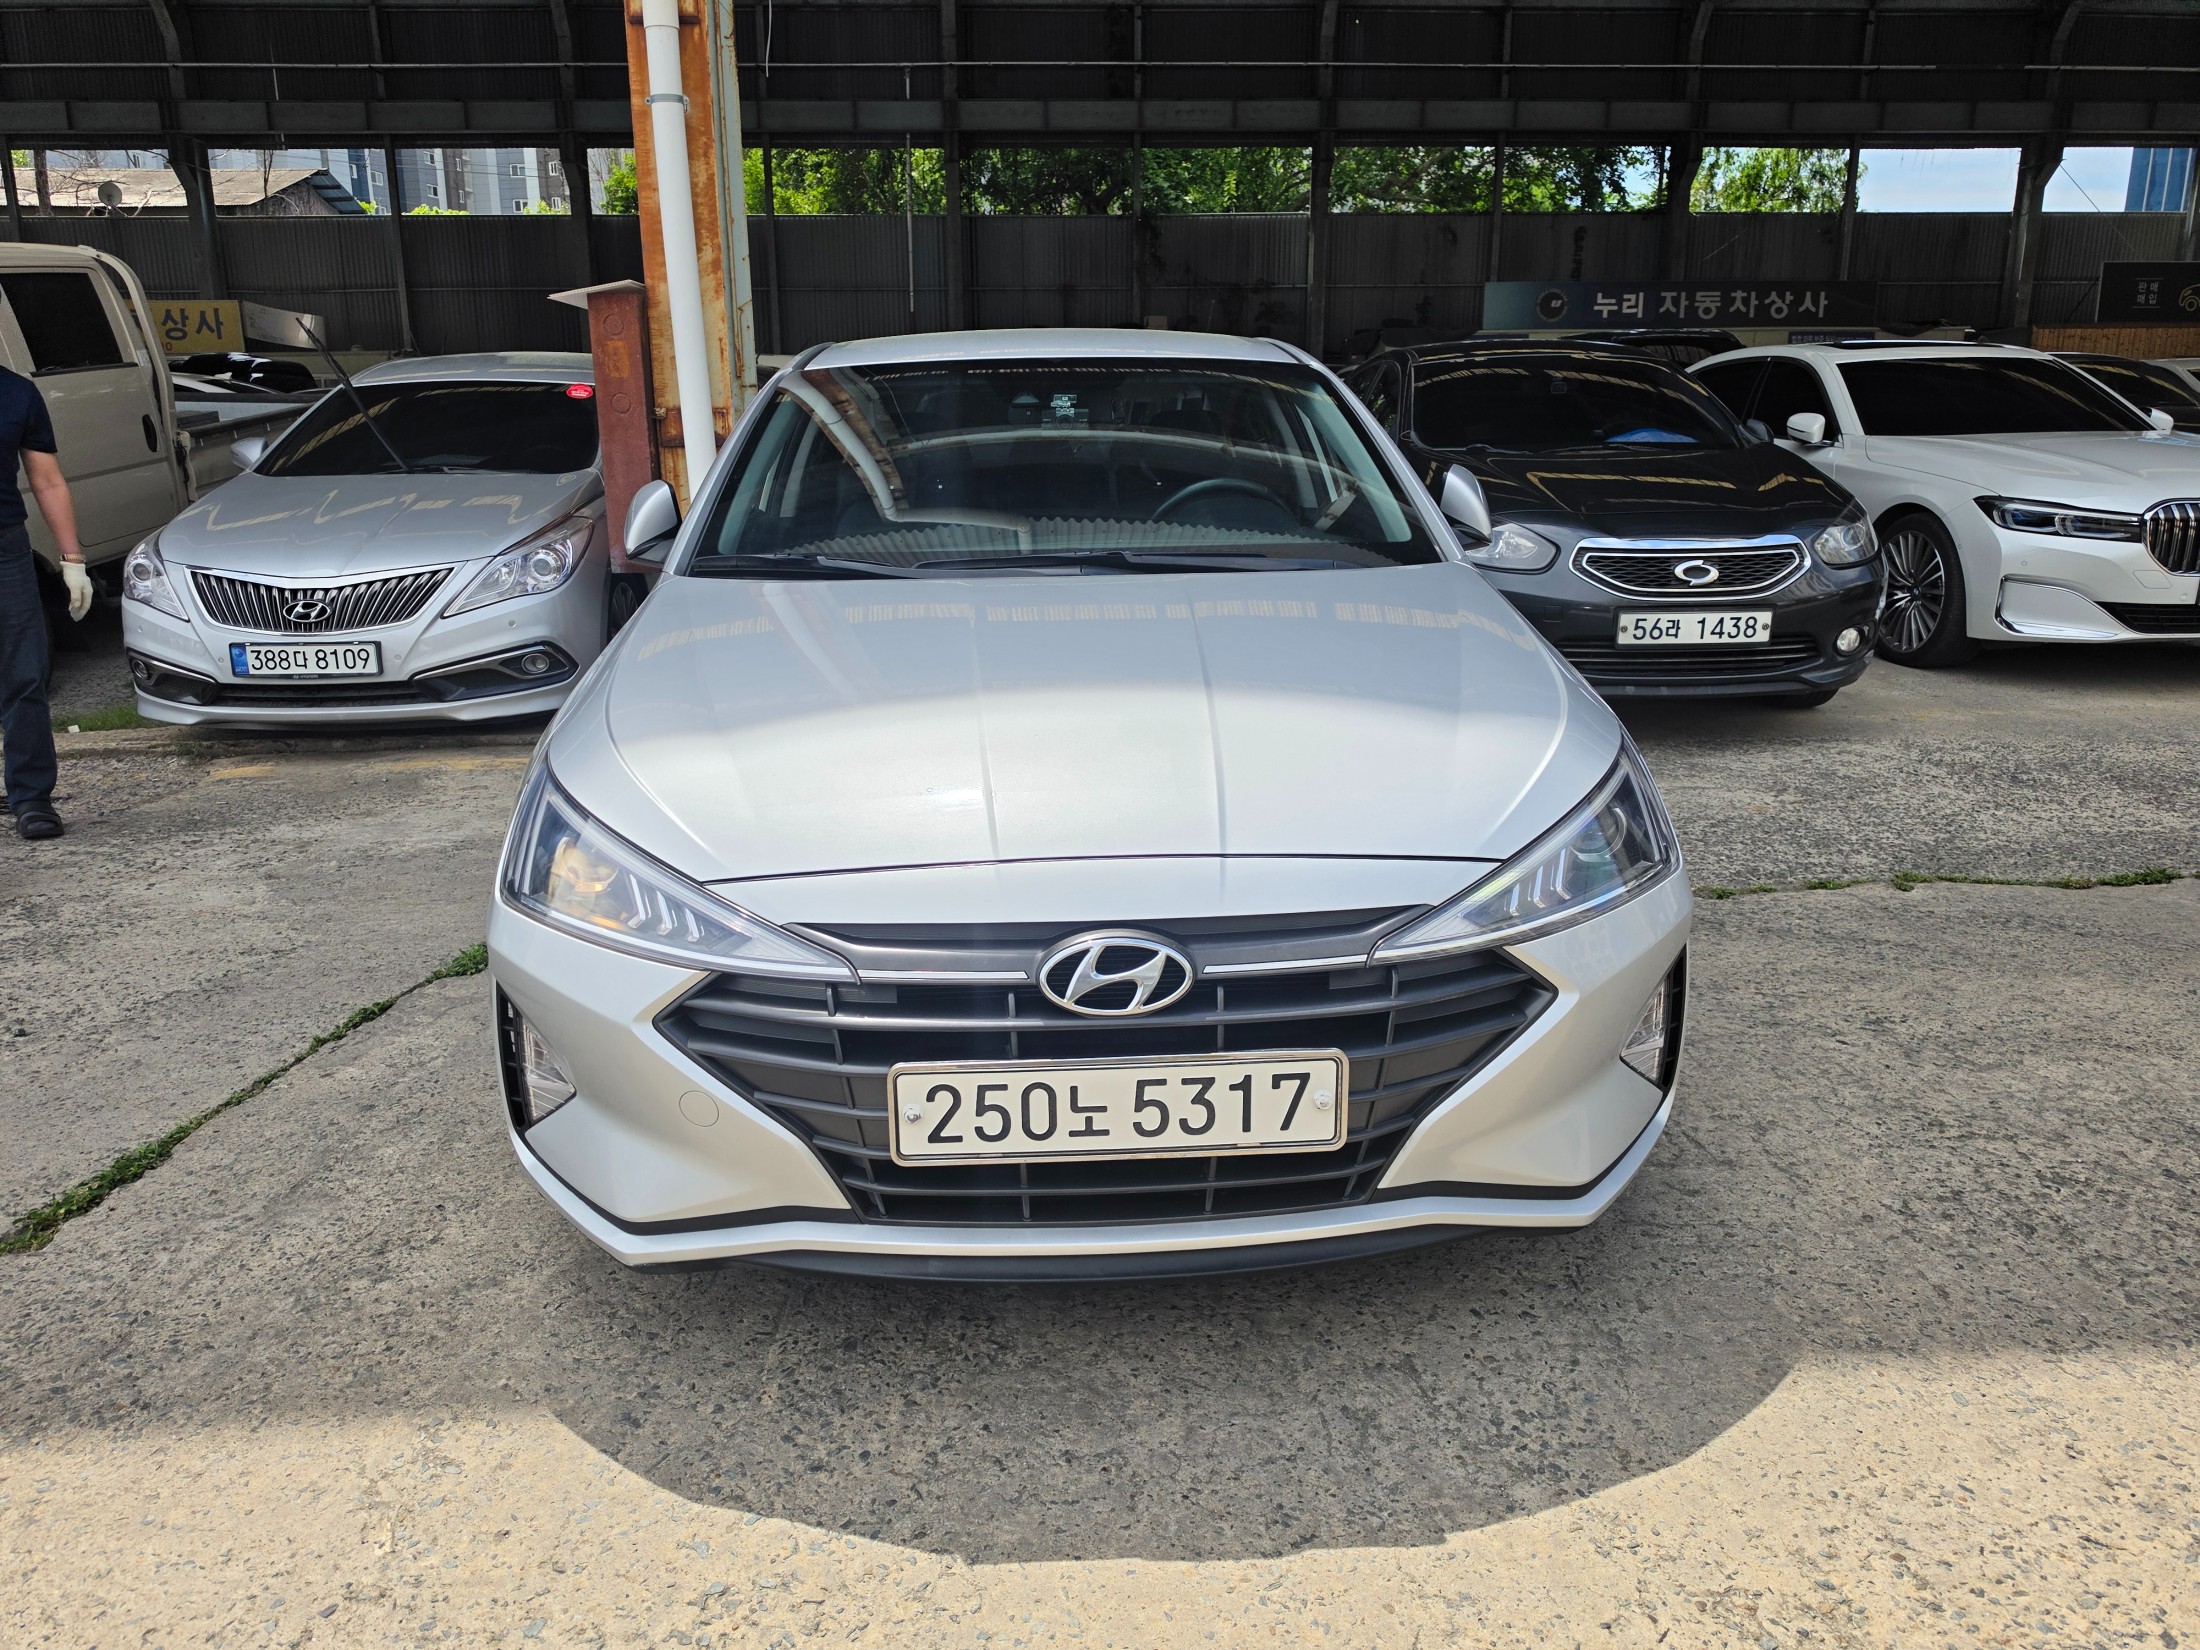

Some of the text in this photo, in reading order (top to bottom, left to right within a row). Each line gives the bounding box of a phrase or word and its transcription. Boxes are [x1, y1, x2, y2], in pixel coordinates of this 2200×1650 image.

[1593, 290, 1829, 320] 누리 자동차상사
[131, 307, 224, 341] 상사
[1632, 616, 1758, 640] 56라 1438
[250, 648, 370, 670] 388다 8109
[925, 1072, 1311, 1144] 250노 5317
